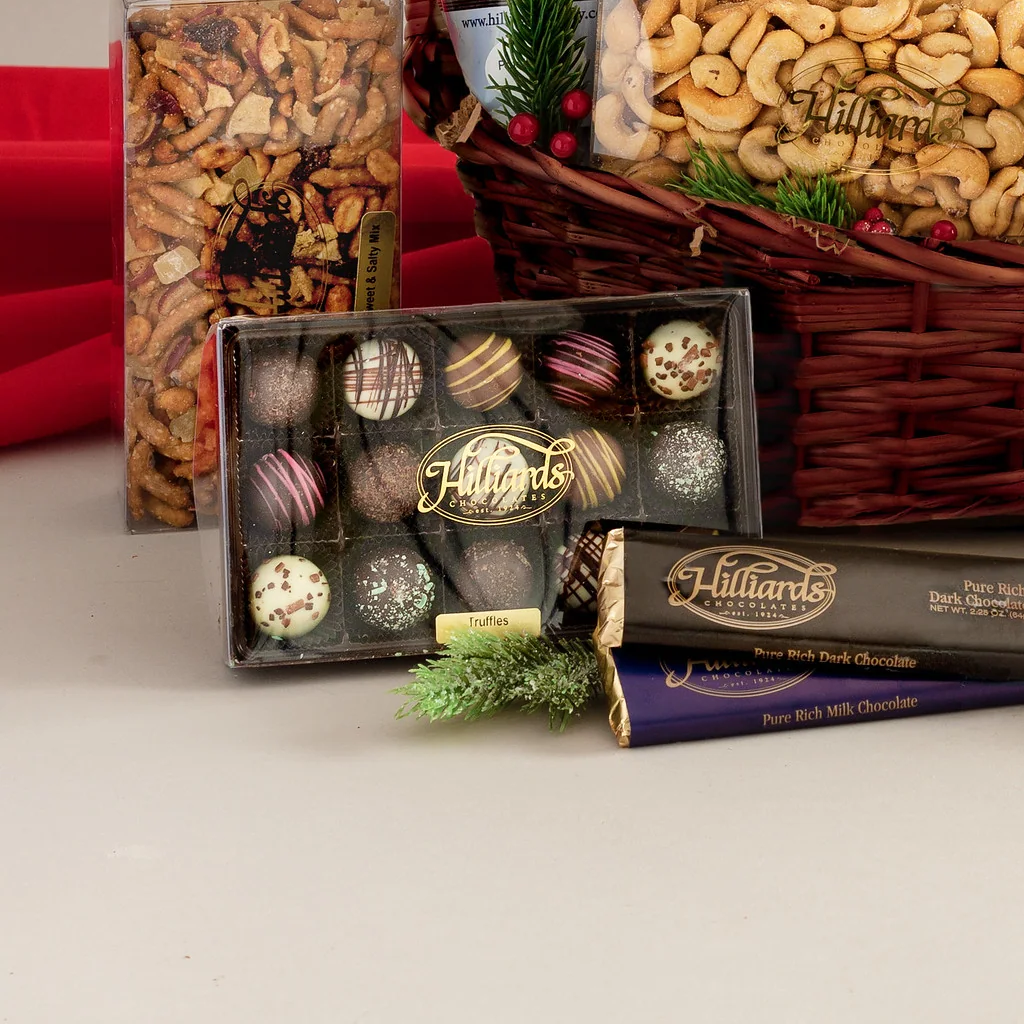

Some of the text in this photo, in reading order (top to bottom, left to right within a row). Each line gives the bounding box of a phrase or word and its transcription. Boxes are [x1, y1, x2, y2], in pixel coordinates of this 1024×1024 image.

[775, 68, 971, 144] Hilliards
[365, 224, 381, 311] weet & Salty Mix
[417, 433, 576, 514] Hilliards
[449, 493, 546, 508] CHOCOLATES
[668, 551, 837, 606] Hilliards
[963, 580, 994, 594] Pure
[928, 590, 962, 605] Dark
[704, 600, 807, 612] CHOCOLATES
[930, 604, 949, 613] NET
[951, 606, 967, 615] WT.
[970, 608, 989, 616] 2.25
[469, 616, 509, 628] Truffles
[755, 611, 777, 619] 1924
[754, 647, 917, 669] Pure Rich Dark Chocolate
[763, 696, 918, 727] Pure Rich Milk Chocolate
